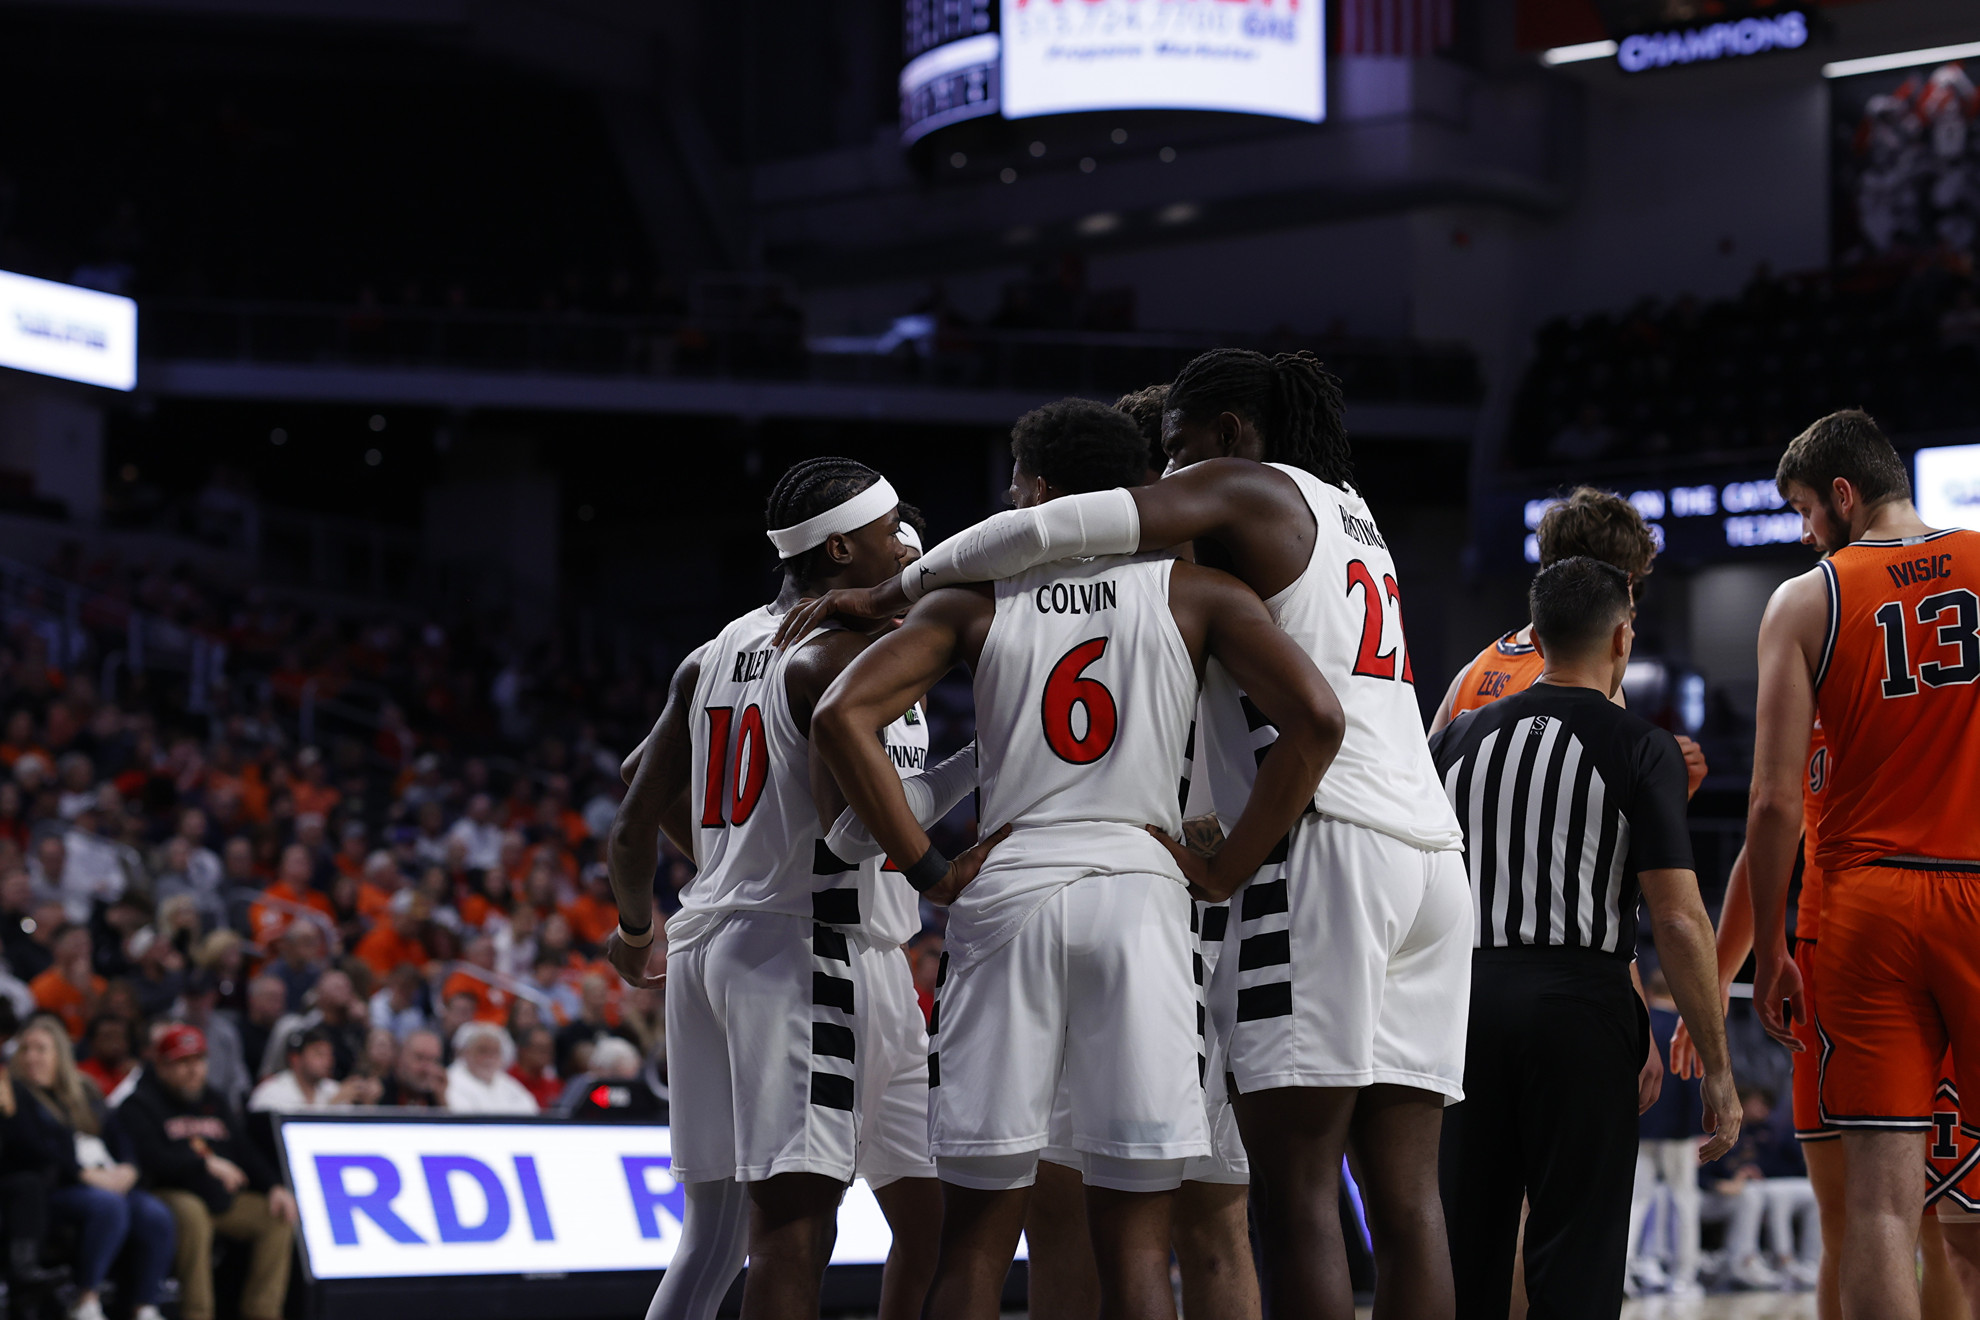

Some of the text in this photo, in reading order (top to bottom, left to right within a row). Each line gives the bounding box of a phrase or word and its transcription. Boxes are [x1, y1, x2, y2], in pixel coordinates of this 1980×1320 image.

[1617, 10, 1808, 72] CHAMPIONS
[1036, 580, 1117, 614] COLVIN
[1886, 554, 1952, 588] IVISIC
[731, 649, 774, 683] RILEY
[1874, 588, 1980, 699] 13
[1041, 636, 1118, 765] 6
[701, 703, 768, 828] 10
[313, 1155, 555, 1245] RDI
